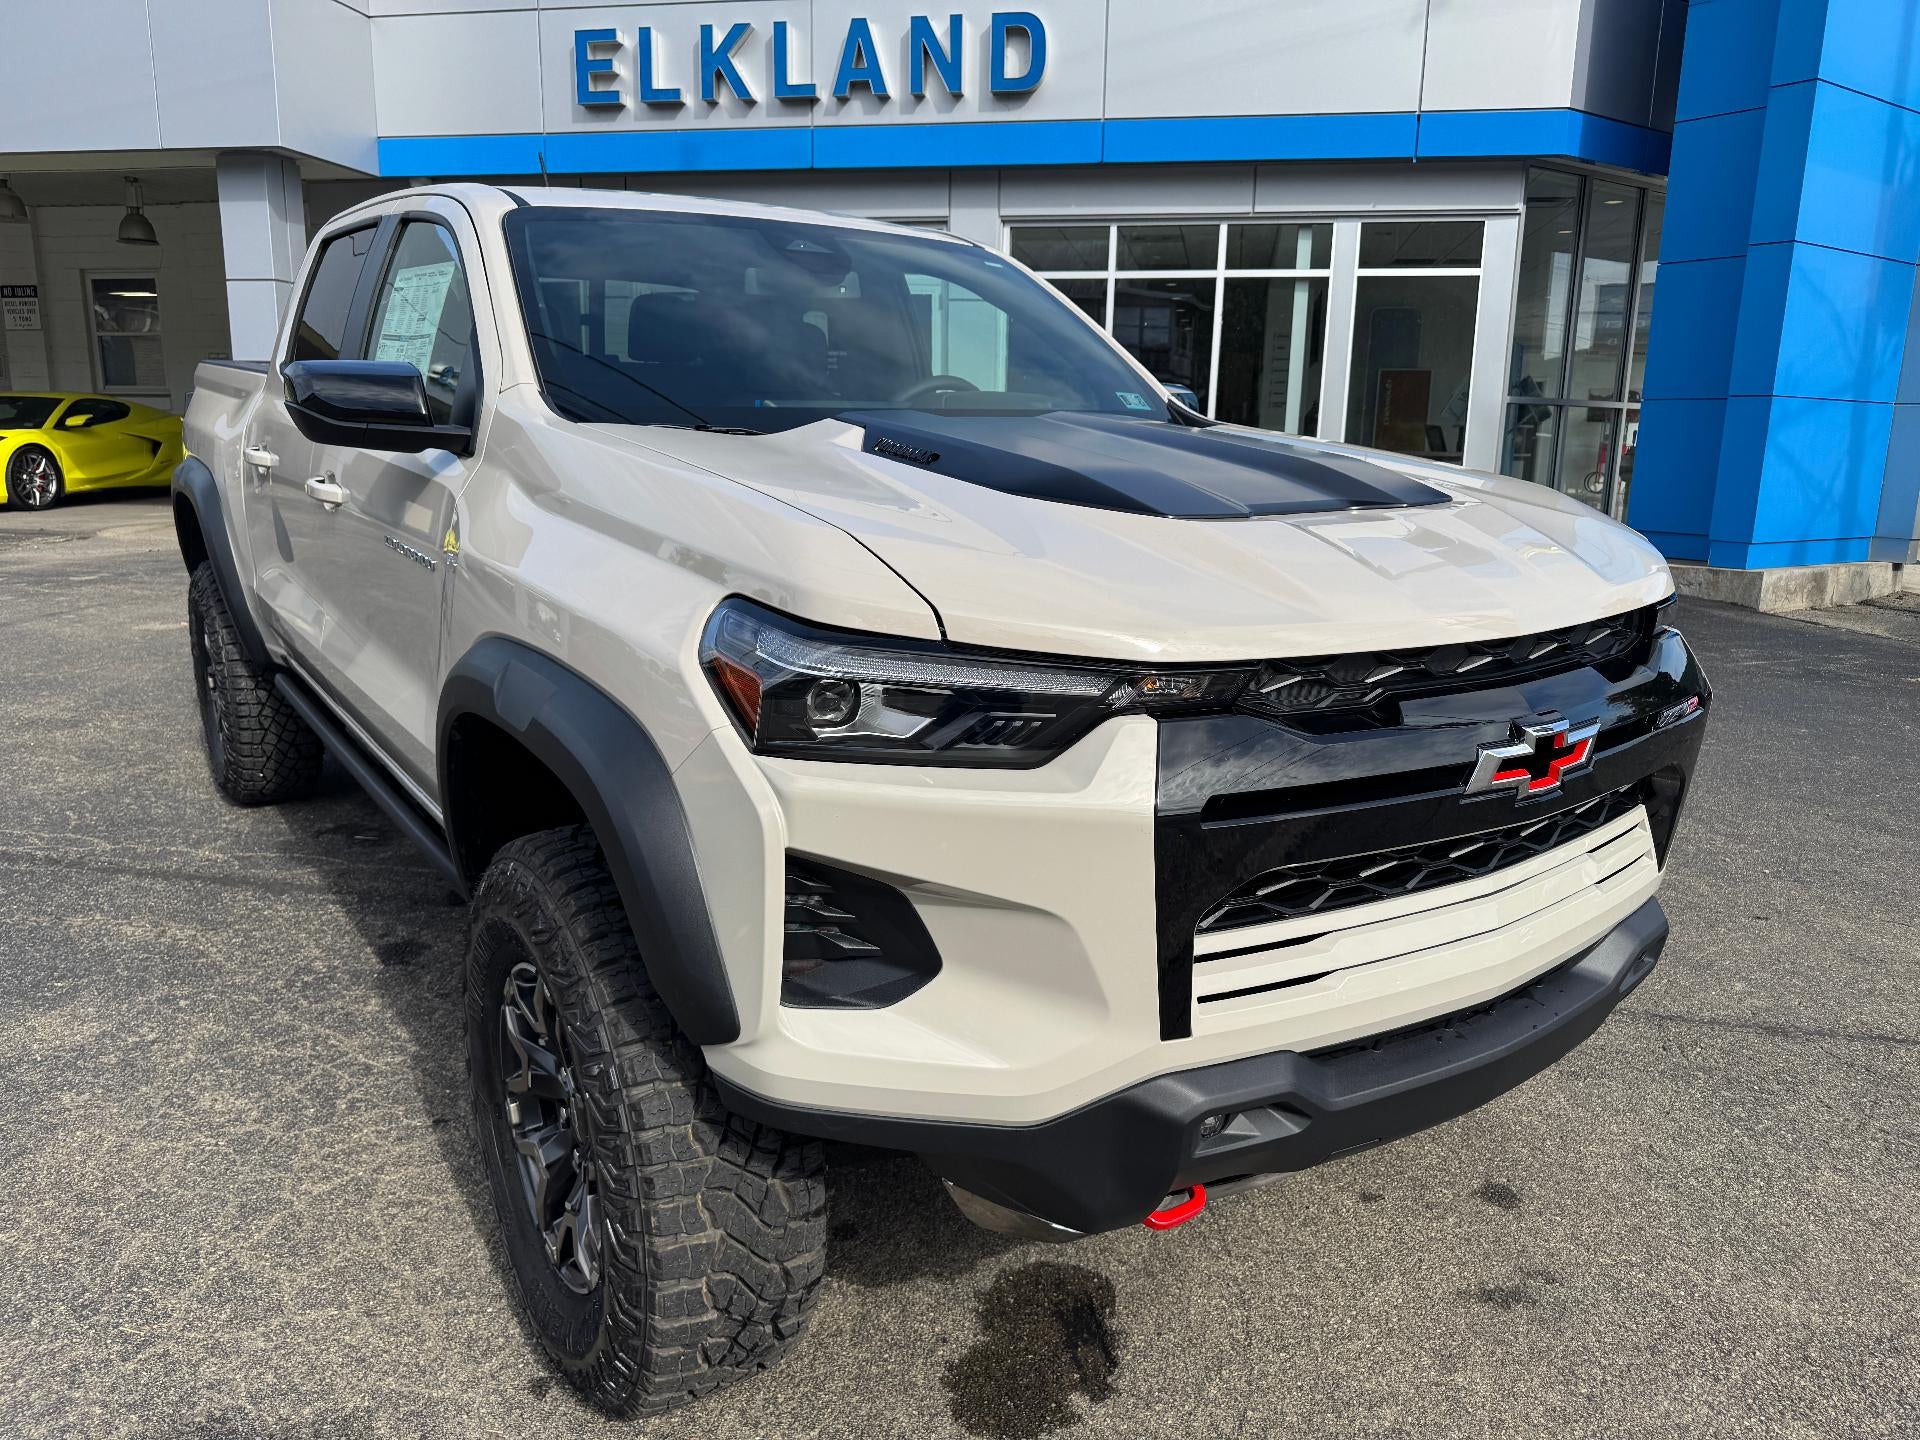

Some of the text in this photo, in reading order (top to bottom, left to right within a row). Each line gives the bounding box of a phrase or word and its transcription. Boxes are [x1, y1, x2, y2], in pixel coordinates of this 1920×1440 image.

[574, 11, 1047, 107] ELKLAND
[3, 287, 35, 297] NO IDLING
